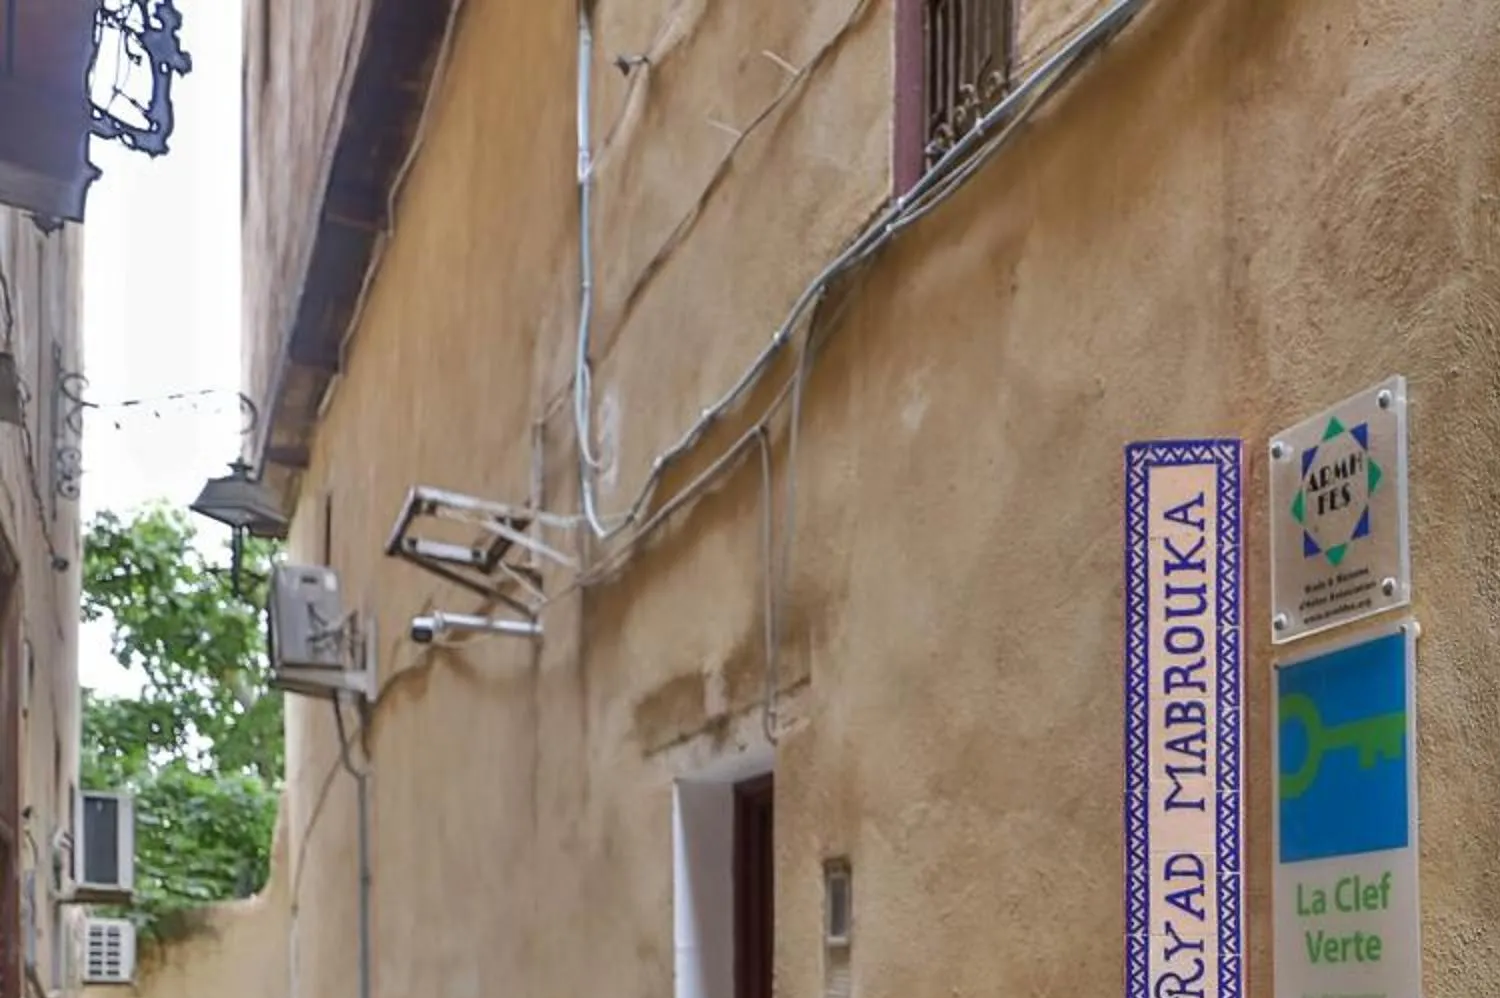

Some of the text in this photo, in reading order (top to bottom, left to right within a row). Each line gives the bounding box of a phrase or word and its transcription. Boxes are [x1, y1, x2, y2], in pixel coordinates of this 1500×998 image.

[1317, 482, 1351, 515] FES
[1163, 491, 1207, 812] MABROUKA
[1296, 870, 1392, 917] La Clef
[1305, 930, 1382, 964] Verte
